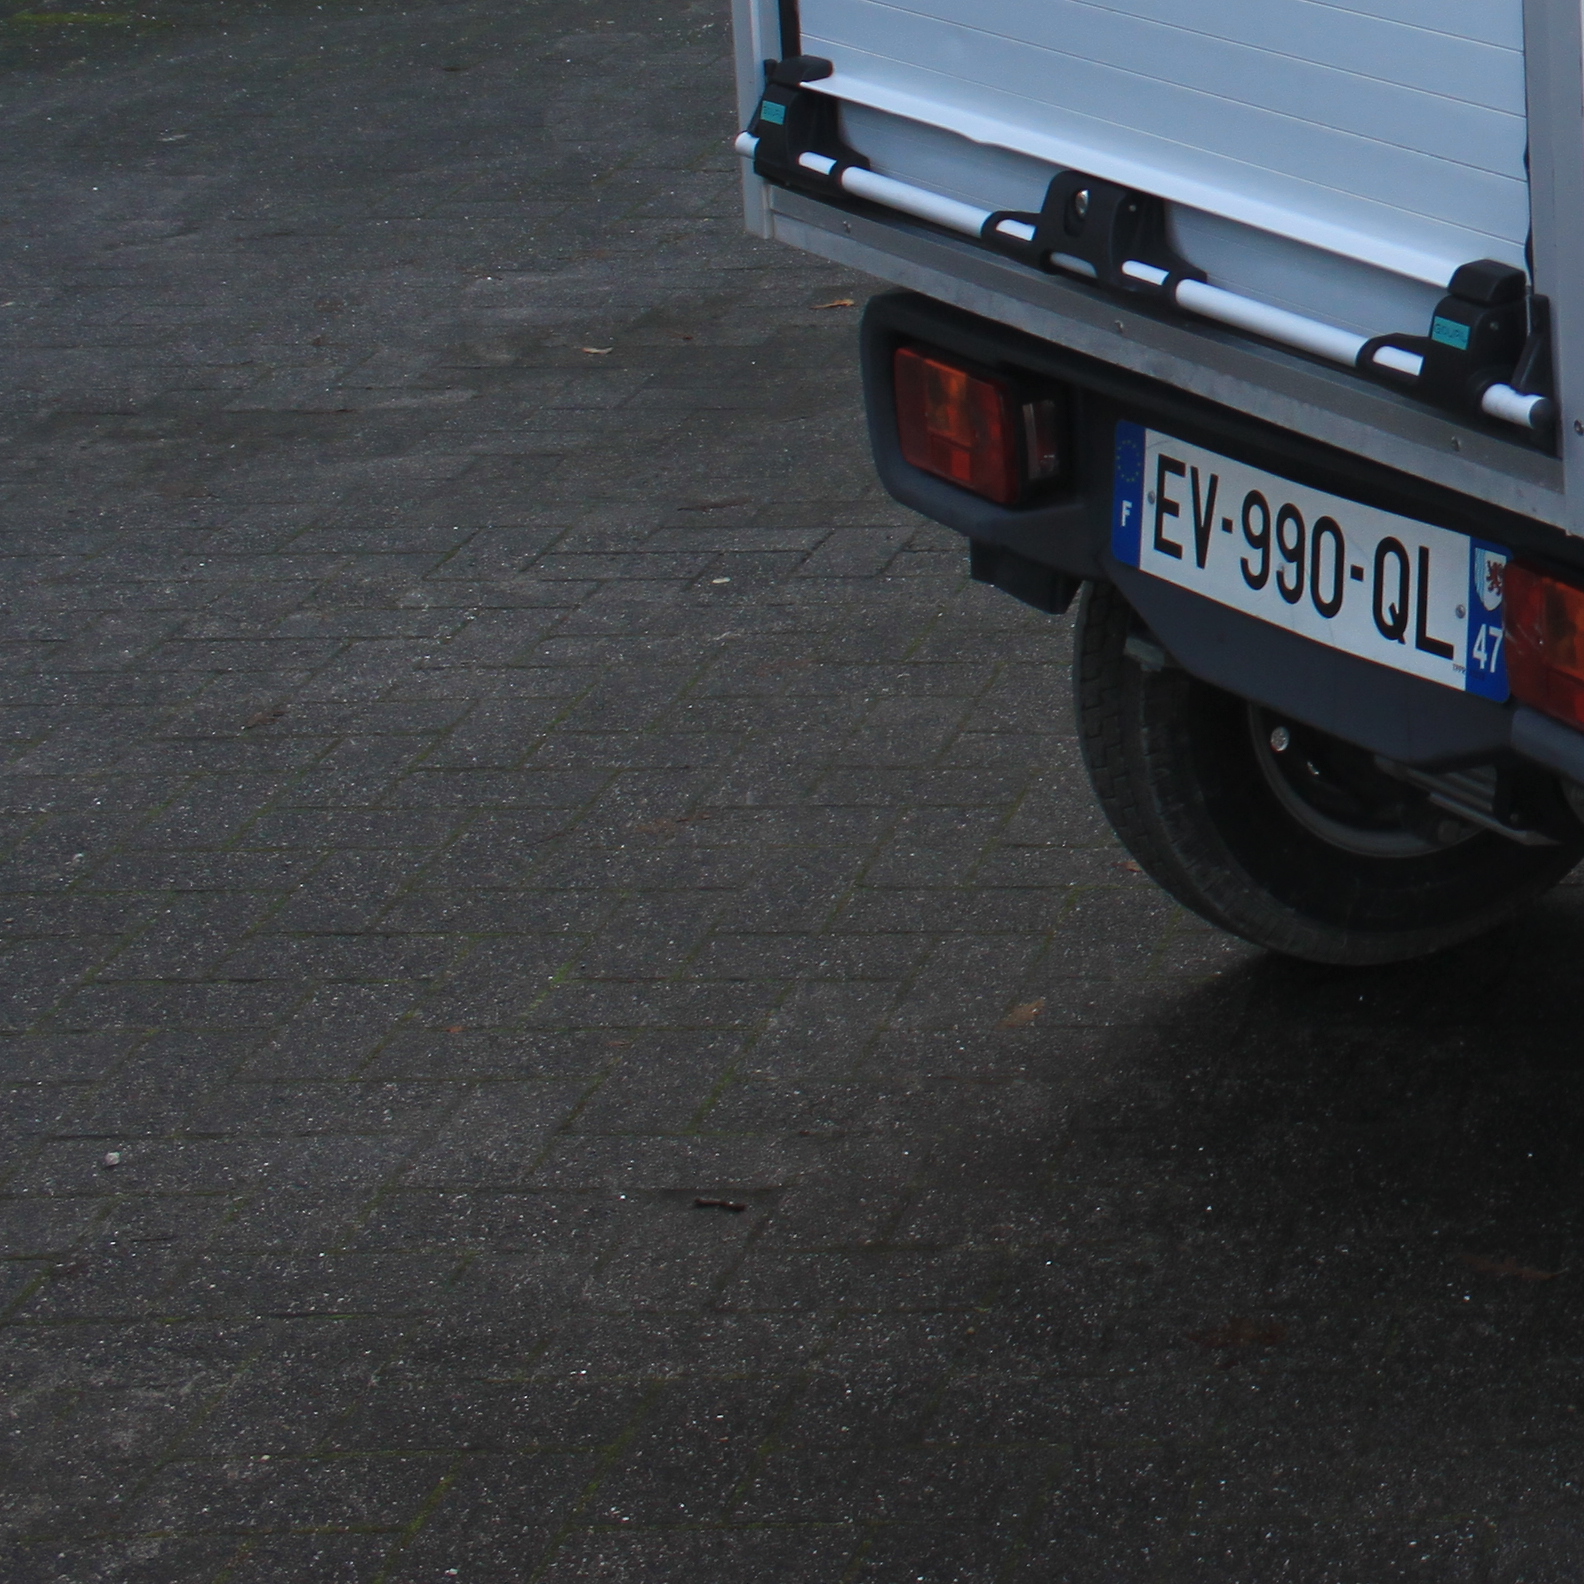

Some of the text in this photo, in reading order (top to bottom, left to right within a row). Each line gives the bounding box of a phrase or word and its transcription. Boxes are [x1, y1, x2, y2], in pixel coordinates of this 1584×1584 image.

[1121, 500, 1132, 527] F
[1153, 453, 1454, 661] EV-990-QL
[1472, 622, 1503, 673] 47
